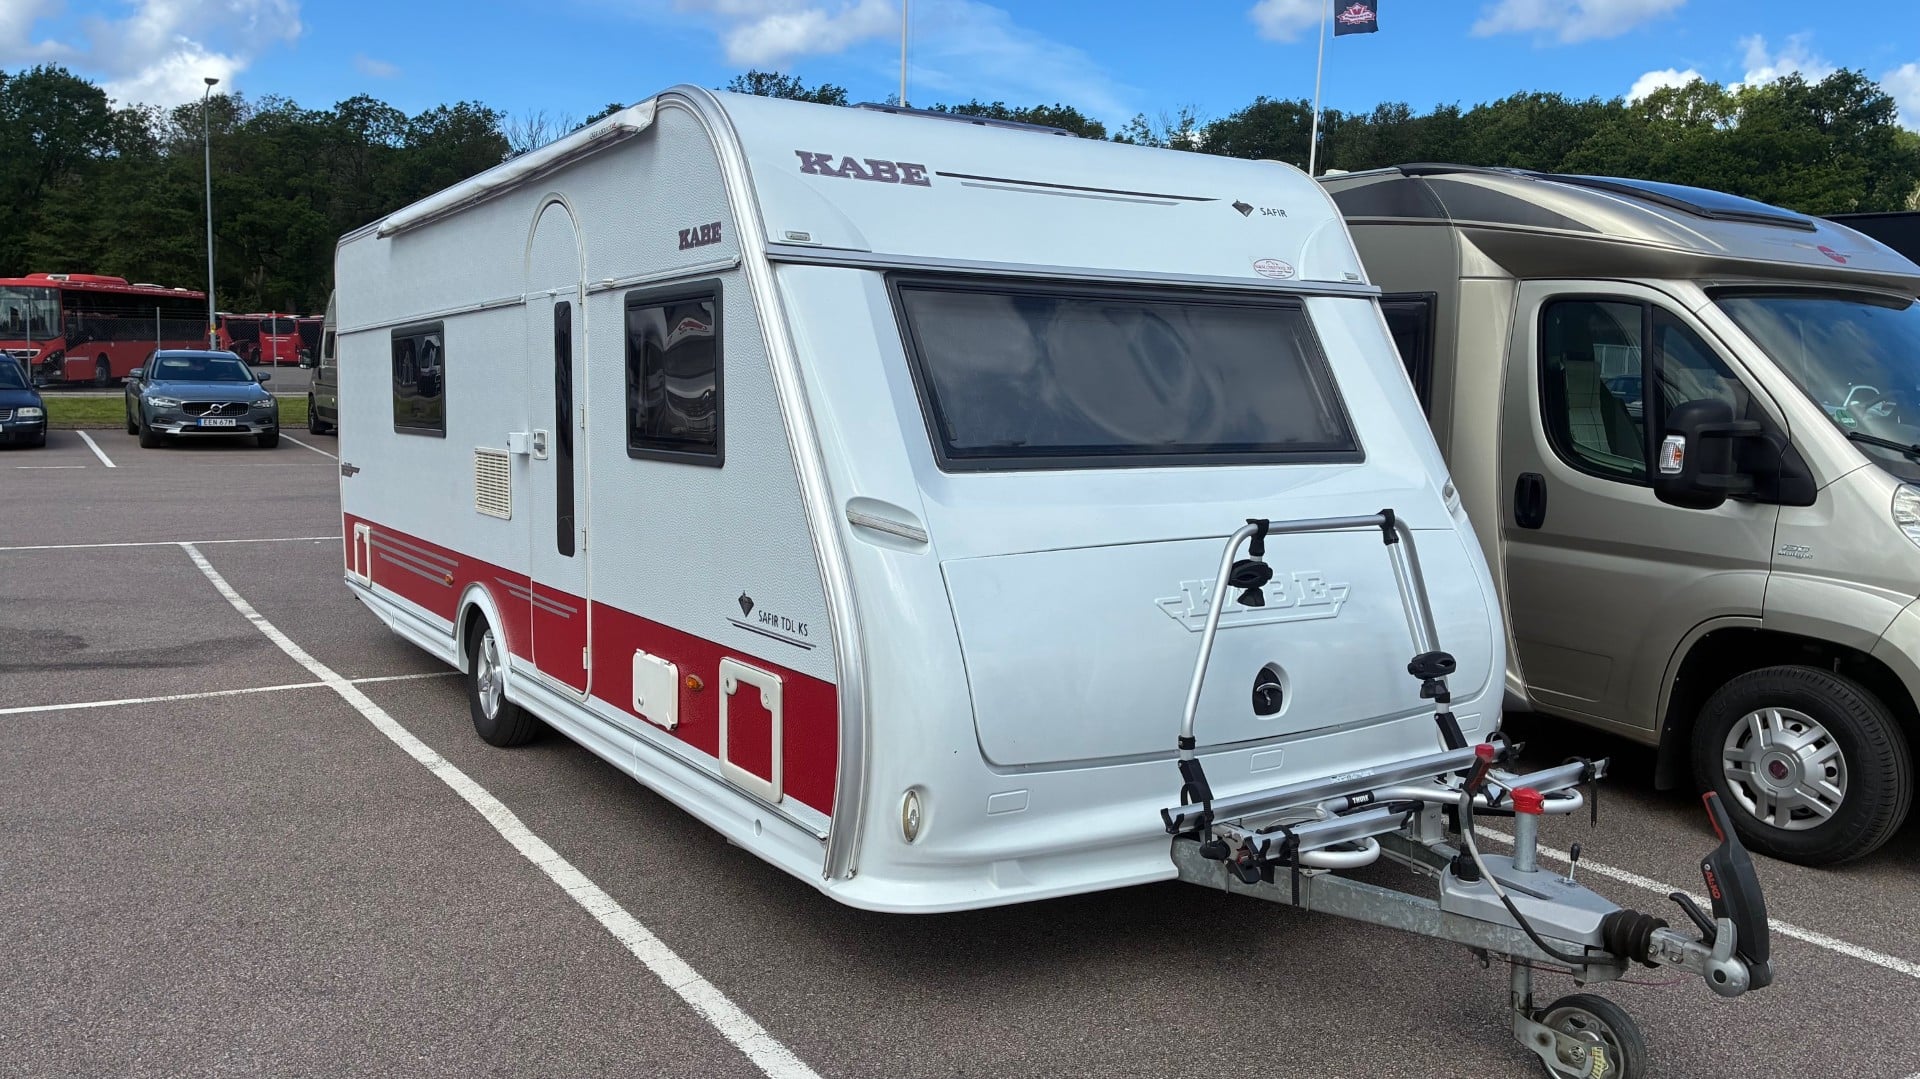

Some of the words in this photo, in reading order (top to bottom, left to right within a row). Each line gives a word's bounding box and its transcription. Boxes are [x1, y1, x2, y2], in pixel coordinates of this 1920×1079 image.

[795, 150, 932, 187] KABE
[1260, 207, 1288, 218] SAFIR
[679, 221, 721, 250] KABE
[1179, 571, 1332, 617] KBE
[759, 610, 779, 627] SAFIR
[781, 616, 796, 633] TDL
[799, 621, 808, 636] KS
